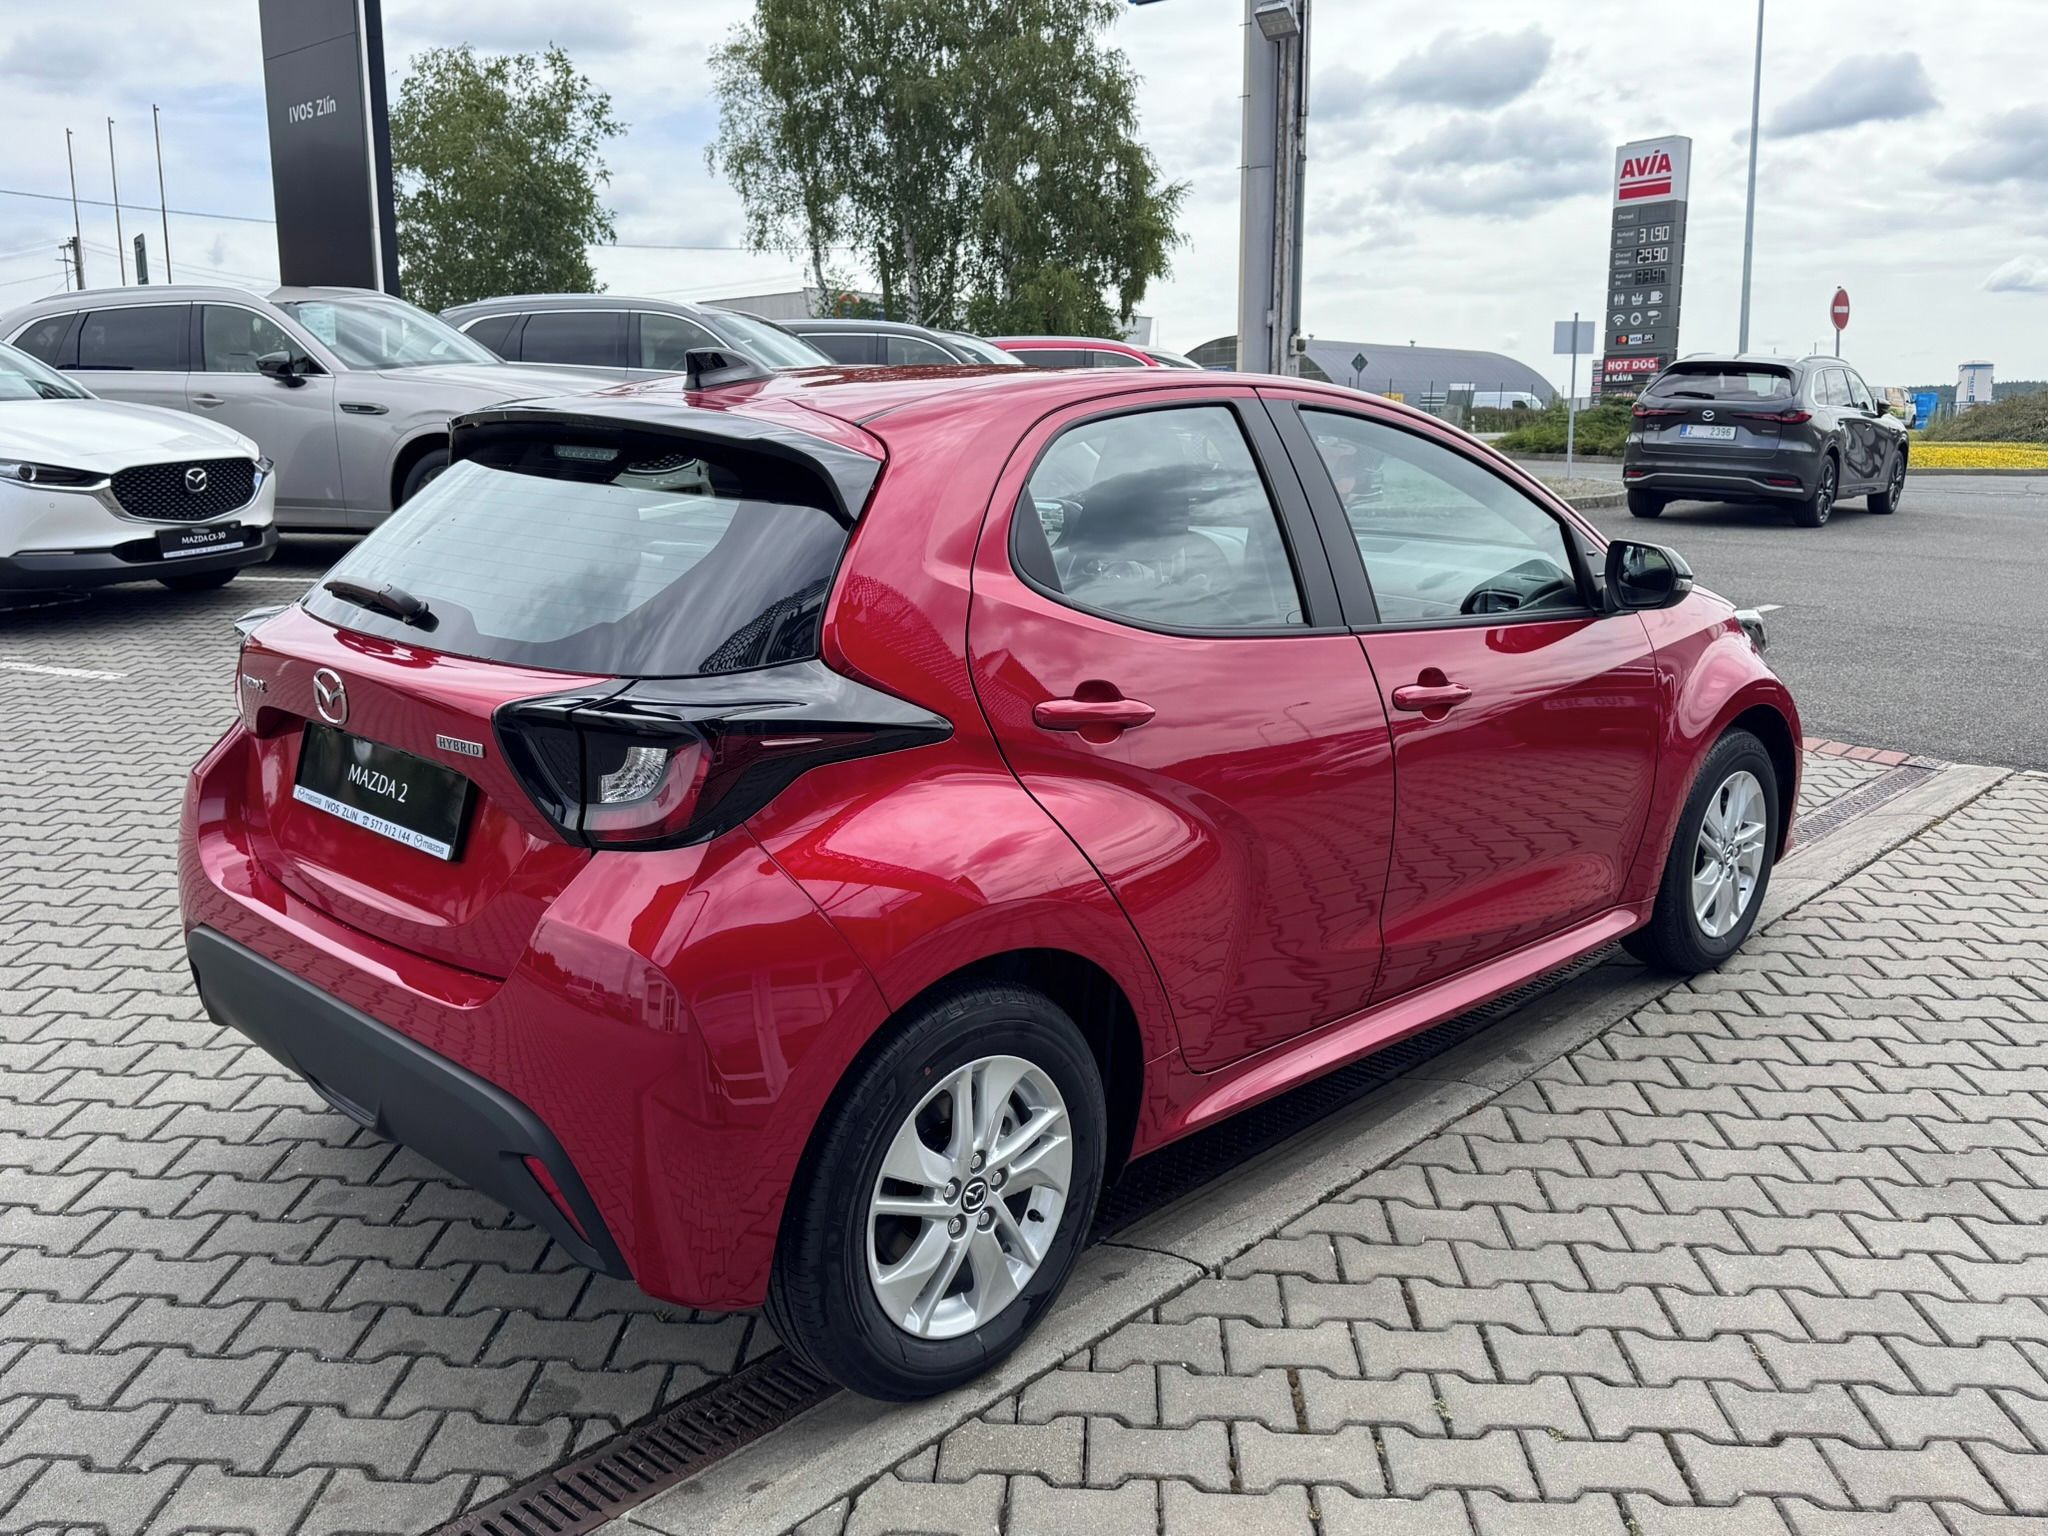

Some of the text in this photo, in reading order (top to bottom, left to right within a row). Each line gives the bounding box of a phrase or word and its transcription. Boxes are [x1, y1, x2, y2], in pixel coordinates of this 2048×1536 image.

[288, 95, 337, 124] IVOS Zlín
[1637, 246, 1669, 264] 29.90
[1607, 359, 1656, 371] HOT DOG
[1612, 372, 1633, 382] KÁVA
[1710, 426, 1732, 437] 2396
[182, 531, 226, 544] MAZDA CX-30
[439, 736, 479, 755] HYBRID
[347, 763, 409, 803] MAZDA 2
[324, 800, 341, 815] IVOS
[370, 818, 383, 832] 577
[384, 823, 397, 837] 912
[398, 828, 411, 842] 144
[422, 840, 445, 855] mazda
